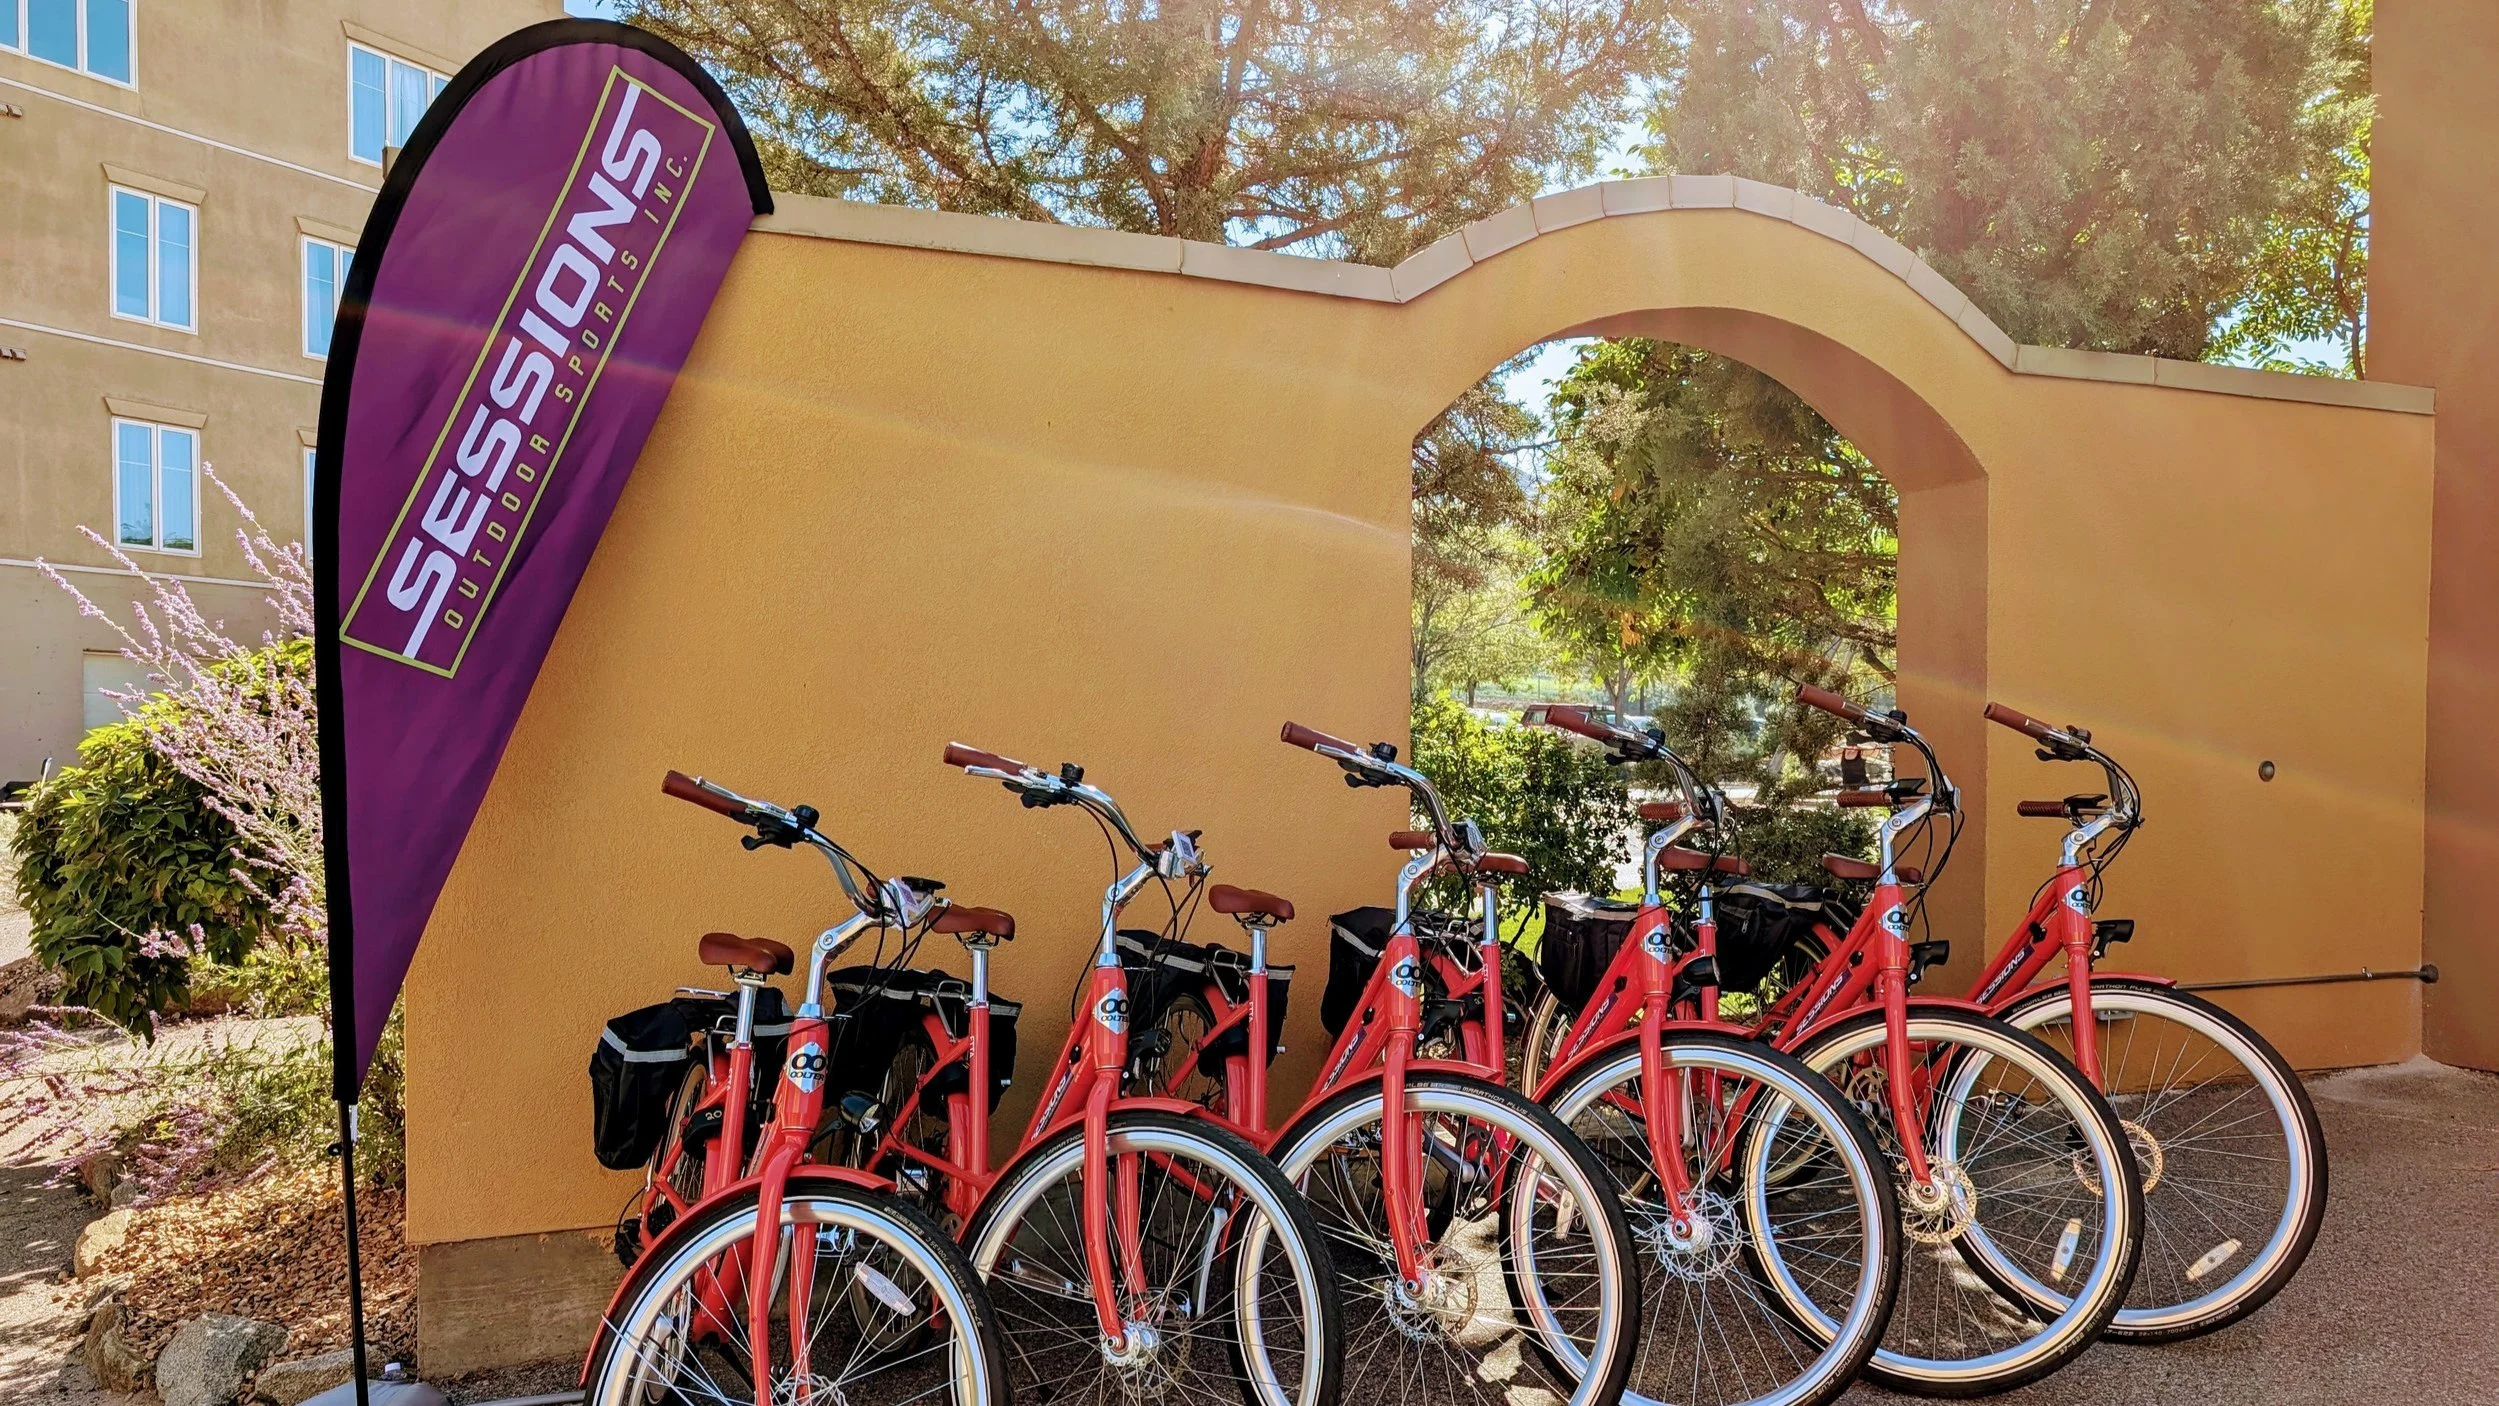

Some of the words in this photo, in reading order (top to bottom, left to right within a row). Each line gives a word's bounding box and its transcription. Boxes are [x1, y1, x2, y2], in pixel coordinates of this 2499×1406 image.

[386, 81, 663, 660] SESSIONS
[443, 435, 551, 630] OUTDOOR
[554, 249, 639, 404] SPORTS
[644, 154, 688, 224] INC.
[1506, 1101, 1529, 1116] PLUS
[1976, 949, 2025, 1005] SESSIONS
